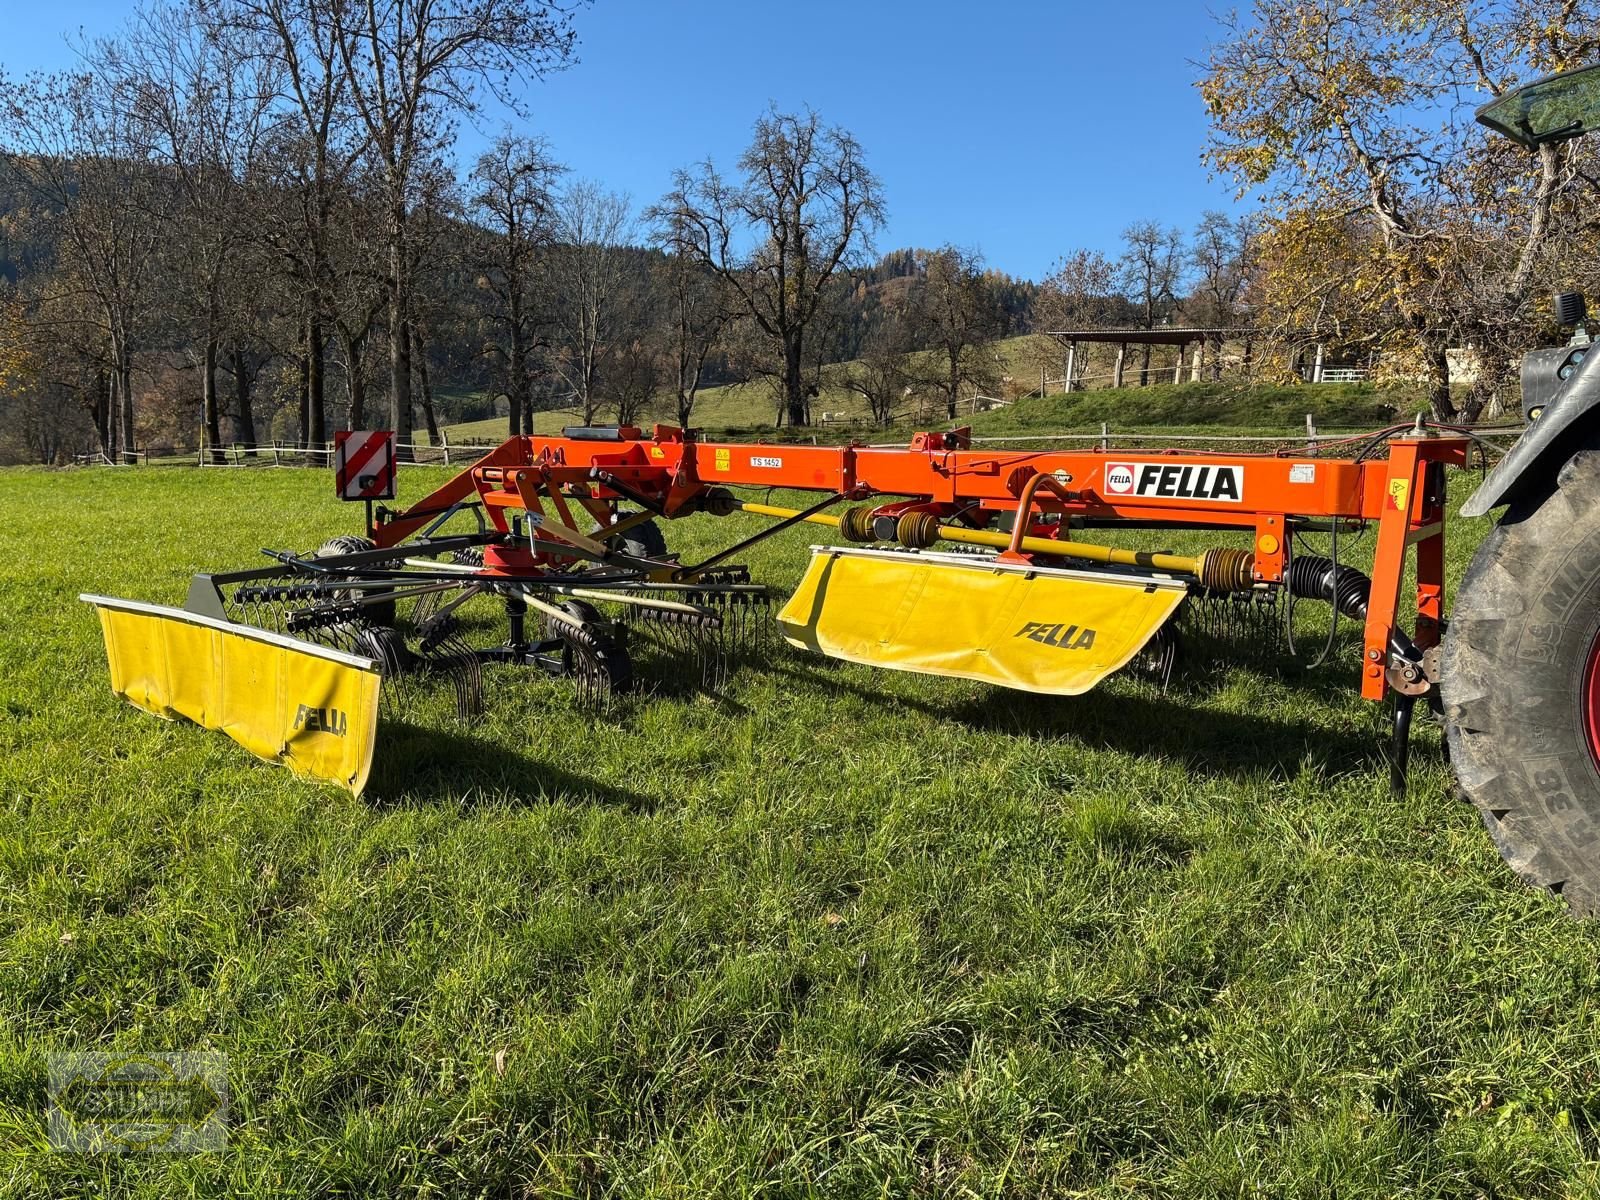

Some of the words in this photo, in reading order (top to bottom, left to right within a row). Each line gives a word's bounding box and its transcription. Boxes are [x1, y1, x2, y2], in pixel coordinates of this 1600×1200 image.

[752, 457, 762, 466] TS
[764, 458, 780, 467] 1452
[1109, 474, 1131, 484] FELLA
[1136, 465, 1239, 500] FELLA
[1013, 621, 1097, 650] FELLA
[293, 703, 347, 737] FELLA
